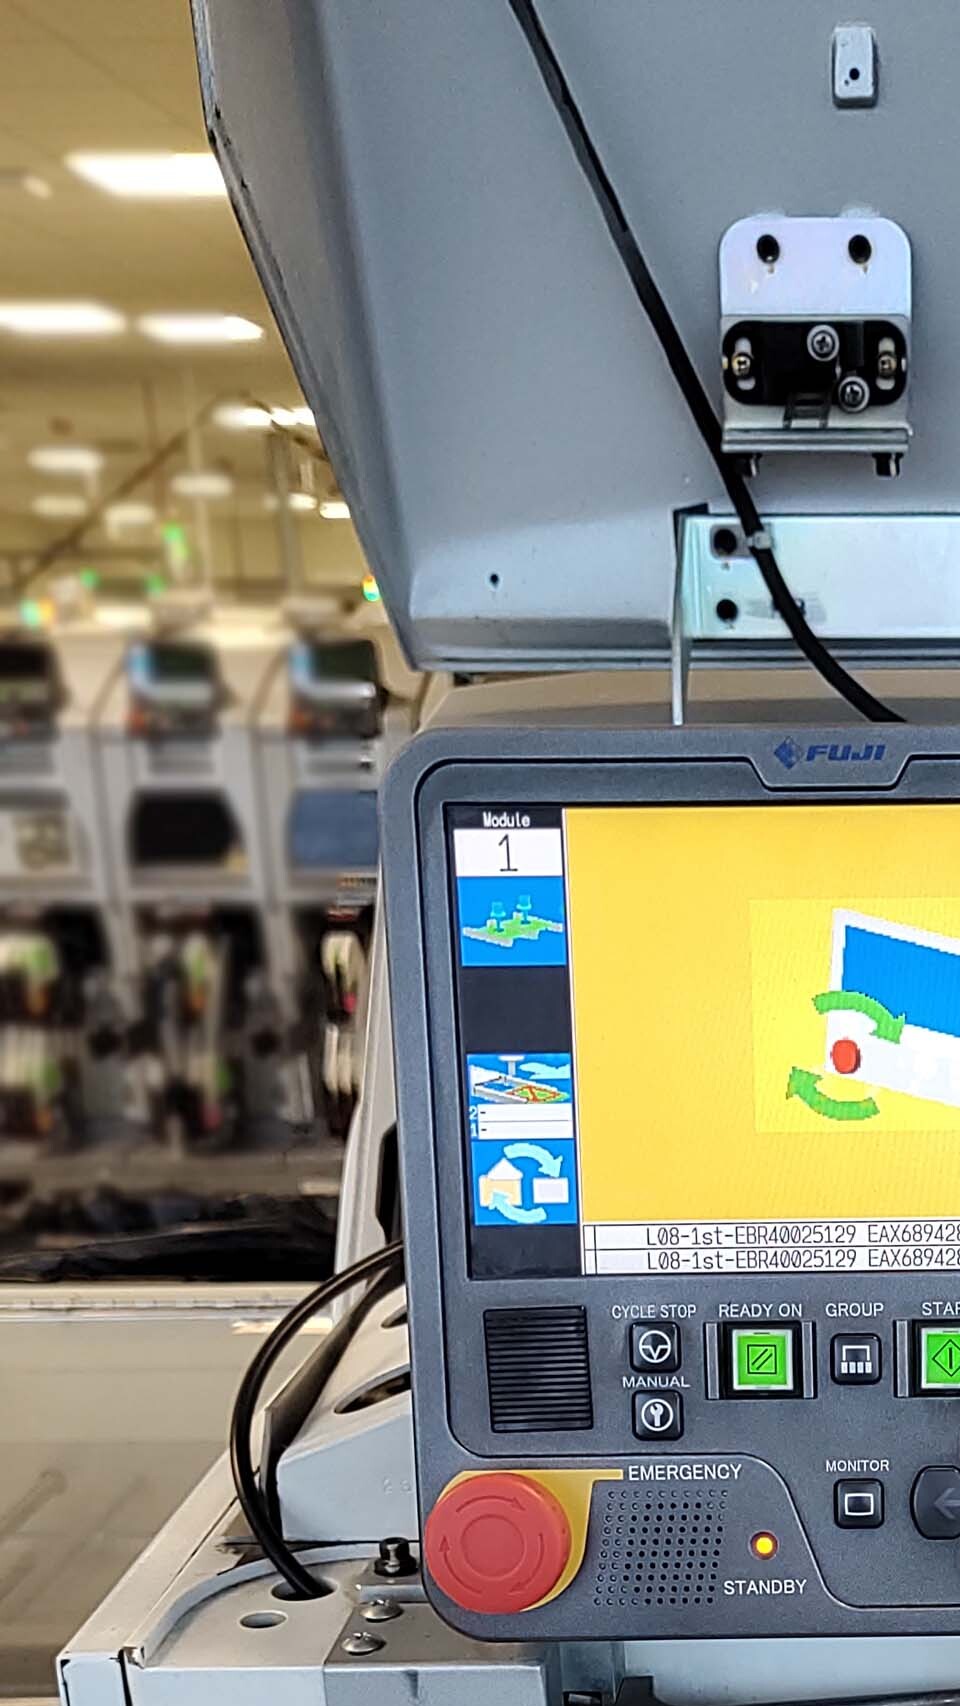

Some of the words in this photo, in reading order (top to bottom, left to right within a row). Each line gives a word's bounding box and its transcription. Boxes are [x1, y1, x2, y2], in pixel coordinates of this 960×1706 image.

[806, 743, 887, 761] FUJI
[482, 811, 531, 828] Module
[498, 833, 519, 872] 1
[468, 1105, 478, 1120] 2
[646, 1224, 857, 1246] L08-1st-EBR40025129
[646, 1249, 857, 1271] L08-1st-EBR40025129
[611, 1304, 656, 1320] CYCLE
[660, 1304, 698, 1319] STOP
[718, 1303, 774, 1318] READY
[778, 1303, 803, 1317] ON
[825, 1302, 885, 1318] GROUP
[622, 1376, 691, 1389] MANUAL
[628, 1463, 743, 1481] EMERGENCY
[825, 1459, 890, 1473] MONITOR
[723, 1579, 808, 1596] STANDBY
